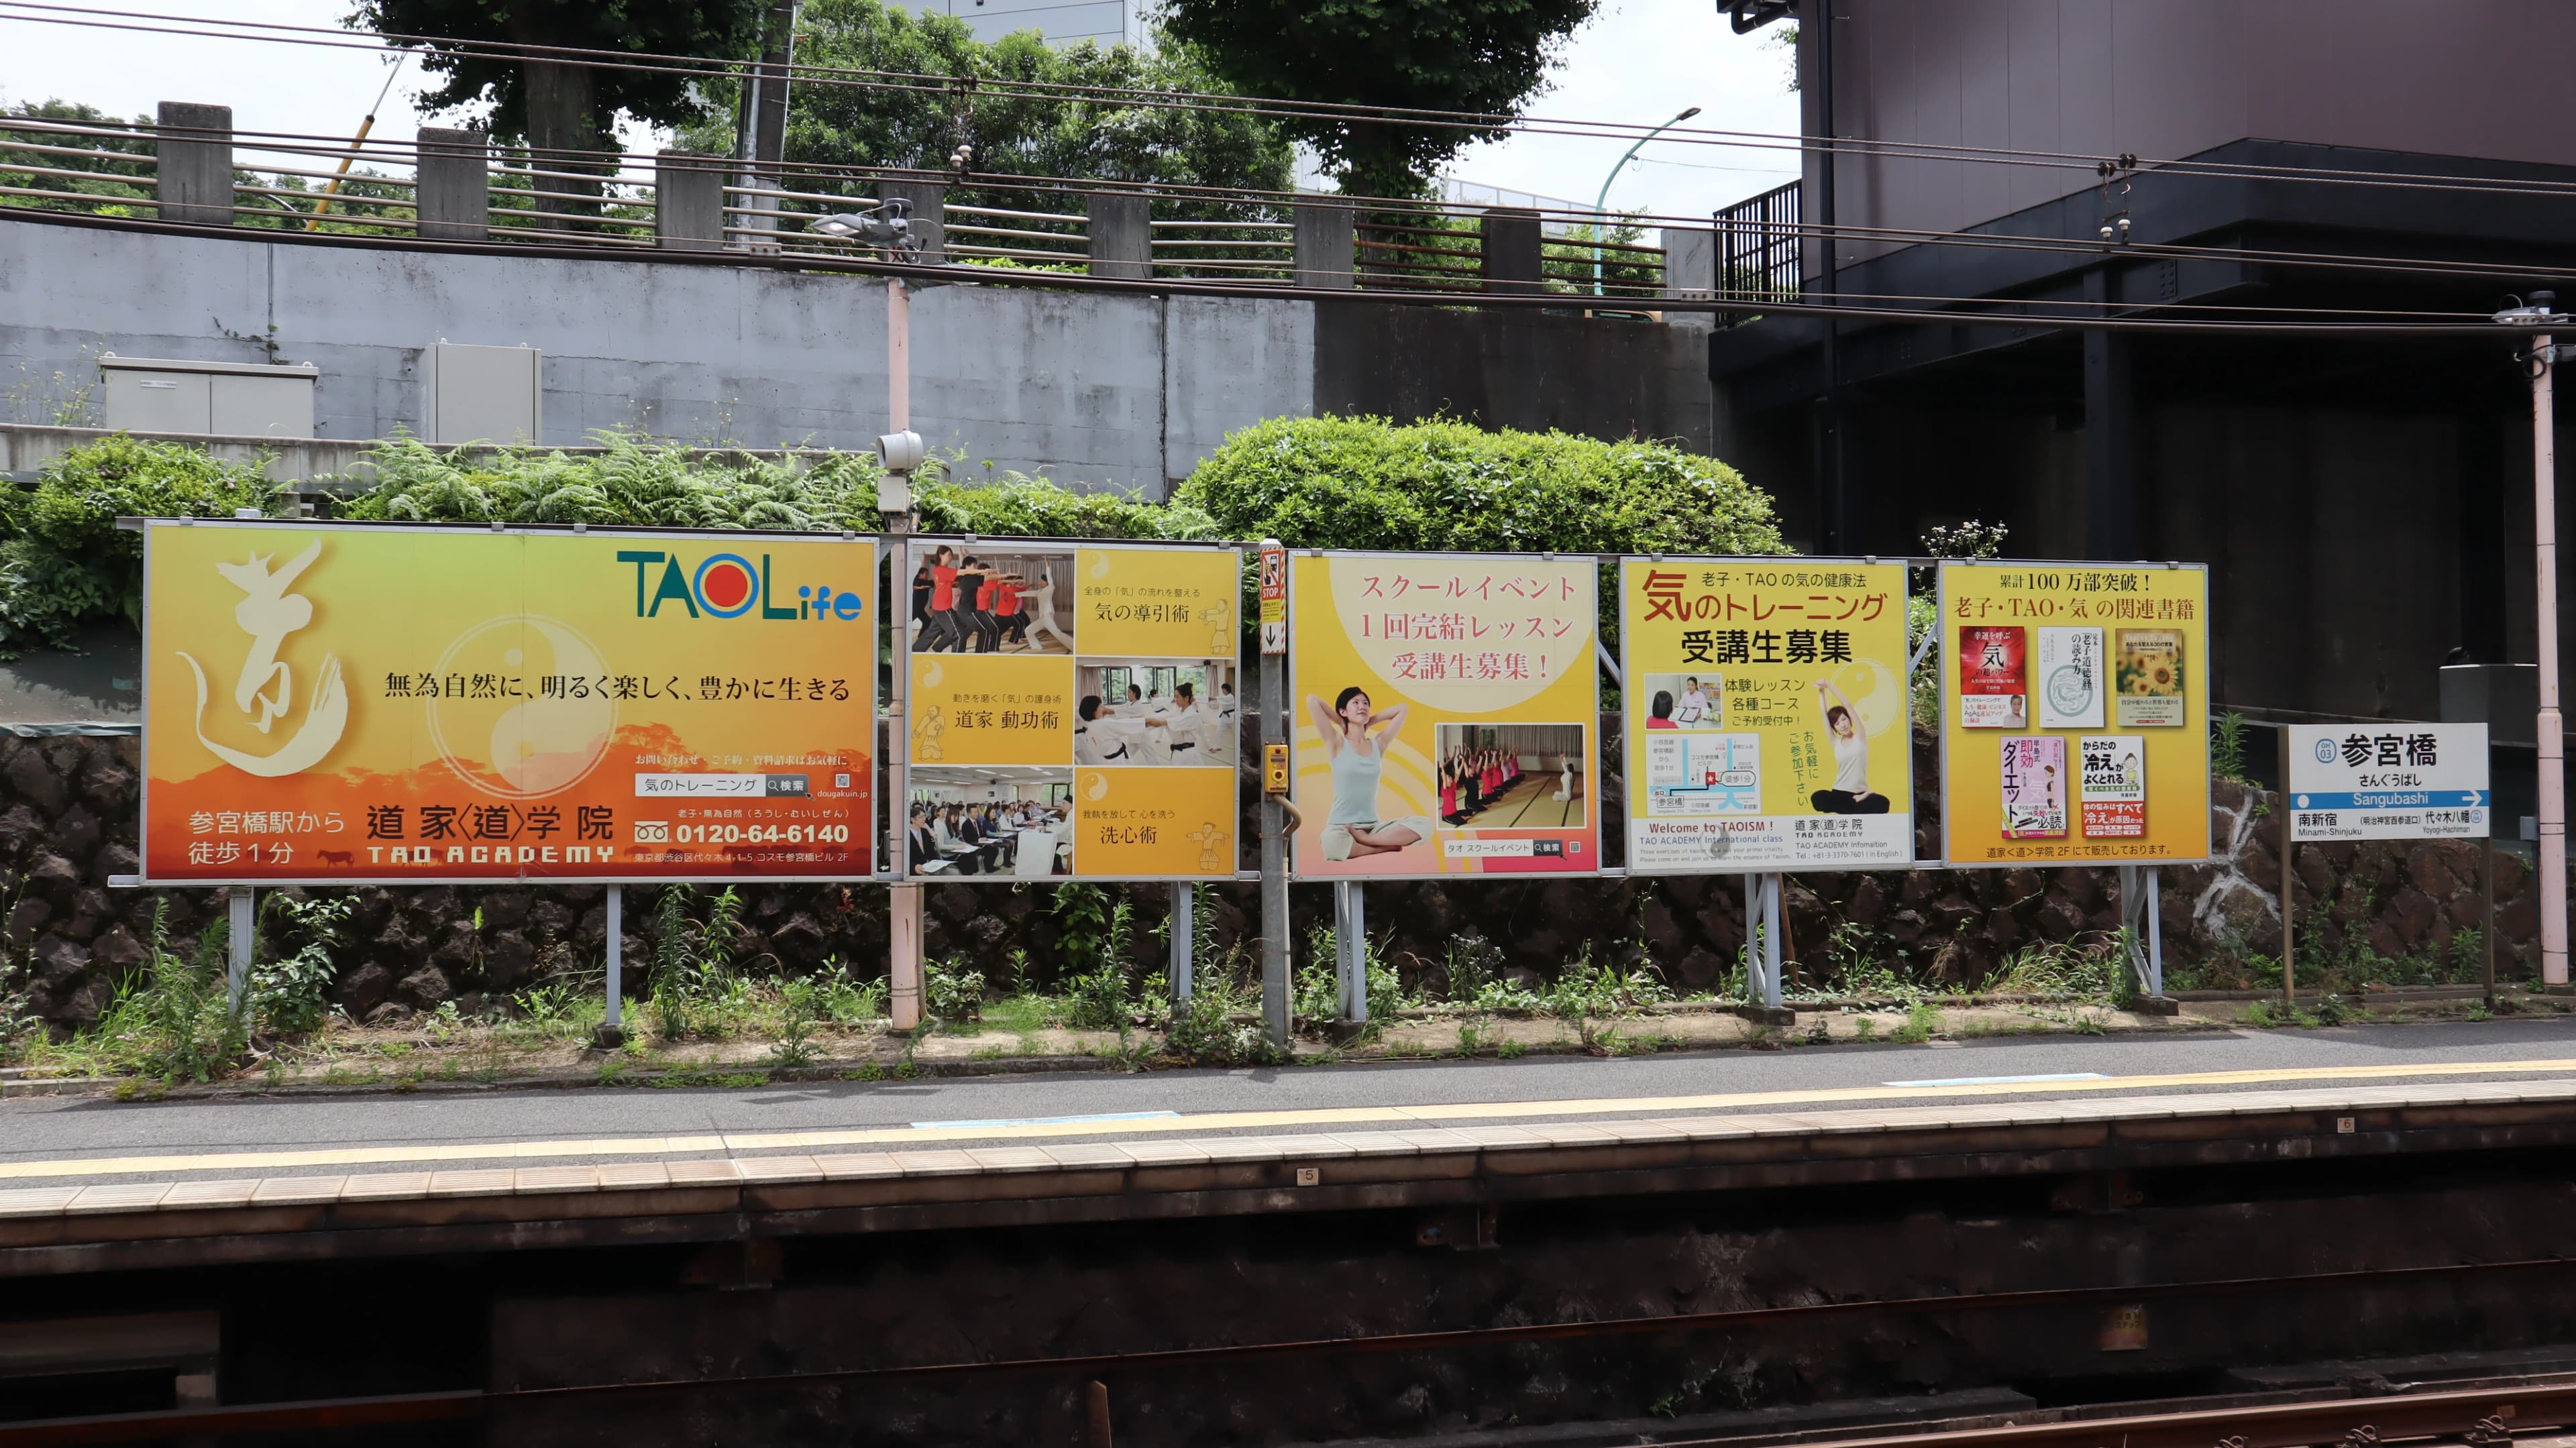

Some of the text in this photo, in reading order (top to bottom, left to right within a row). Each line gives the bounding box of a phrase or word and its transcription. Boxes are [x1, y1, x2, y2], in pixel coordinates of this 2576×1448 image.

[1084, 586, 1200, 598] 全身の「気」の流れを整える
[1263, 588, 1279, 598] STOP
[1360, 574, 1575, 602] スクールイベント
[1642, 570, 1888, 622] 気のトレーニング
[1094, 603, 1189, 623] 気の導引術
[1361, 613, 1574, 641] 1回完結レッスン
[1974, 631, 2010, 640] 幸運を呼ぶ
[1681, 630, 1852, 664] 受講生募集
[1981, 642, 2004, 668] 気
[2072, 634, 2081, 675] の読み方
[1392, 653, 1548, 680] 受講生募集！
[385, 672, 851, 702] 無為自然に、明るく楽しく、豊かに生きる
[1725, 679, 1805, 693] 体験レッスン
[953, 693, 1062, 704] 動きを磨く「気」の護身術
[1731, 698, 1799, 711] 各種コース
[2083, 741, 2116, 750] からだの
[2341, 734, 2437, 768] 参宮橋
[1804, 731, 1819, 779] お気軽に
[2020, 740, 2033, 768] 即効
[2320, 750, 2332, 759] 03
[1790, 733, 1808, 806] ご参加下さい
[645, 779, 804, 792] 気のトレーニング 検索
[2003, 740, 2020, 823] ダイエット
[2084, 773, 2124, 784] よくとれる
[2359, 773, 2422, 787] さんぐうばし
[817, 789, 867, 799] dougakuin.jp
[2353, 791, 2428, 807] Sangubashi
[1659, 798, 1682, 806] 参宮橋
[189, 810, 345, 834] 参宮橋駅から
[2298, 812, 2337, 826] 南新宿
[2426, 810, 2470, 824] 代々木八幡
[676, 824, 849, 843] 0120-64-6140
[1100, 826, 1157, 844] 洗心術
[1650, 823, 1699, 834] Welcome
[1705, 824, 1716, 833] to
[1721, 822, 1765, 832] TAOISM
[2298, 828, 2362, 838] Minami-Shinjuku
[2422, 826, 2470, 834] Yoyogi-Hachiman
[1640, 835, 1783, 845] TAO ACADEMY International class
[367, 845, 614, 864] TAO ACADEMY
[1467, 844, 1529, 852] スクールイベント
[1543, 843, 1560, 852] 検索
[2344, 1119, 2351, 1128] 6
[1305, 1170, 1313, 1180] 5
